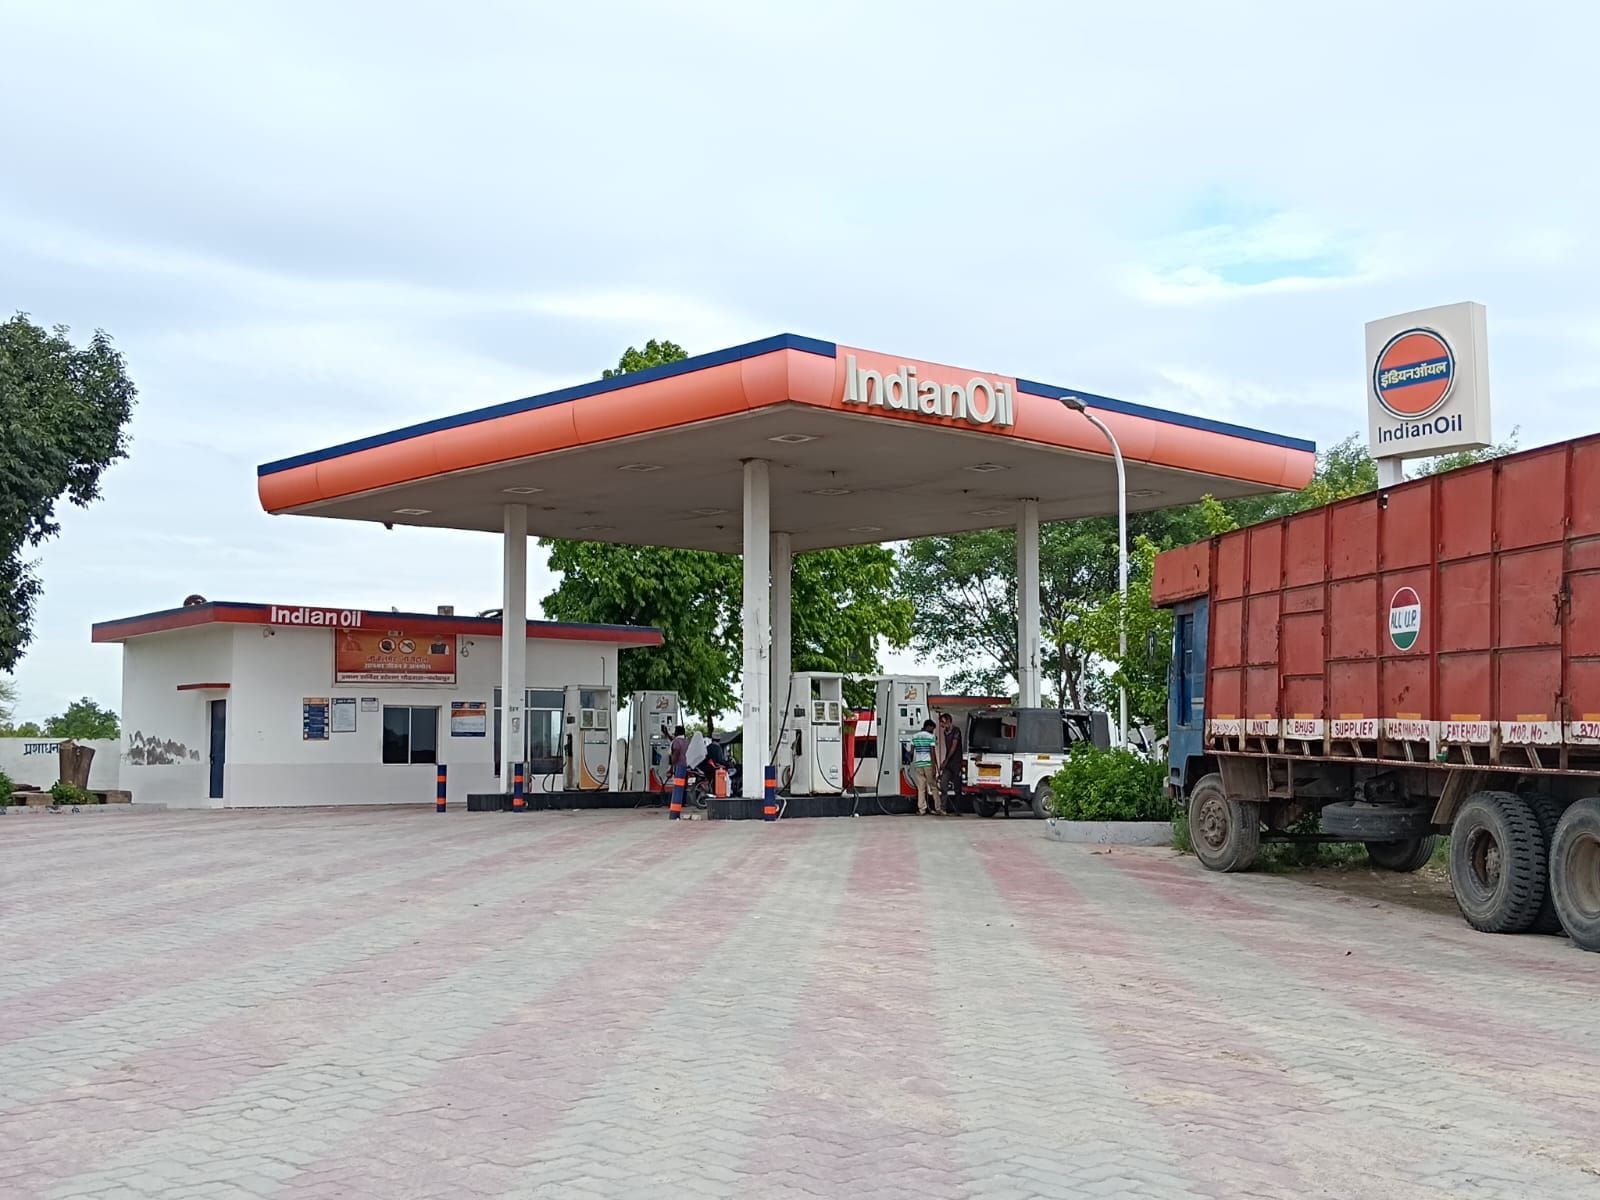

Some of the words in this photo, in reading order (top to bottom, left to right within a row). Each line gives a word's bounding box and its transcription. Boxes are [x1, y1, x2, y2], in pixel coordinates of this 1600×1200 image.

[842, 354, 1015, 427] IndianOil
[1378, 414, 1462, 443] IndianOil
[271, 606, 337, 625] Indian
[340, 610, 361, 627] Oil
[1335, 721, 1374, 736] SUPPLIER
